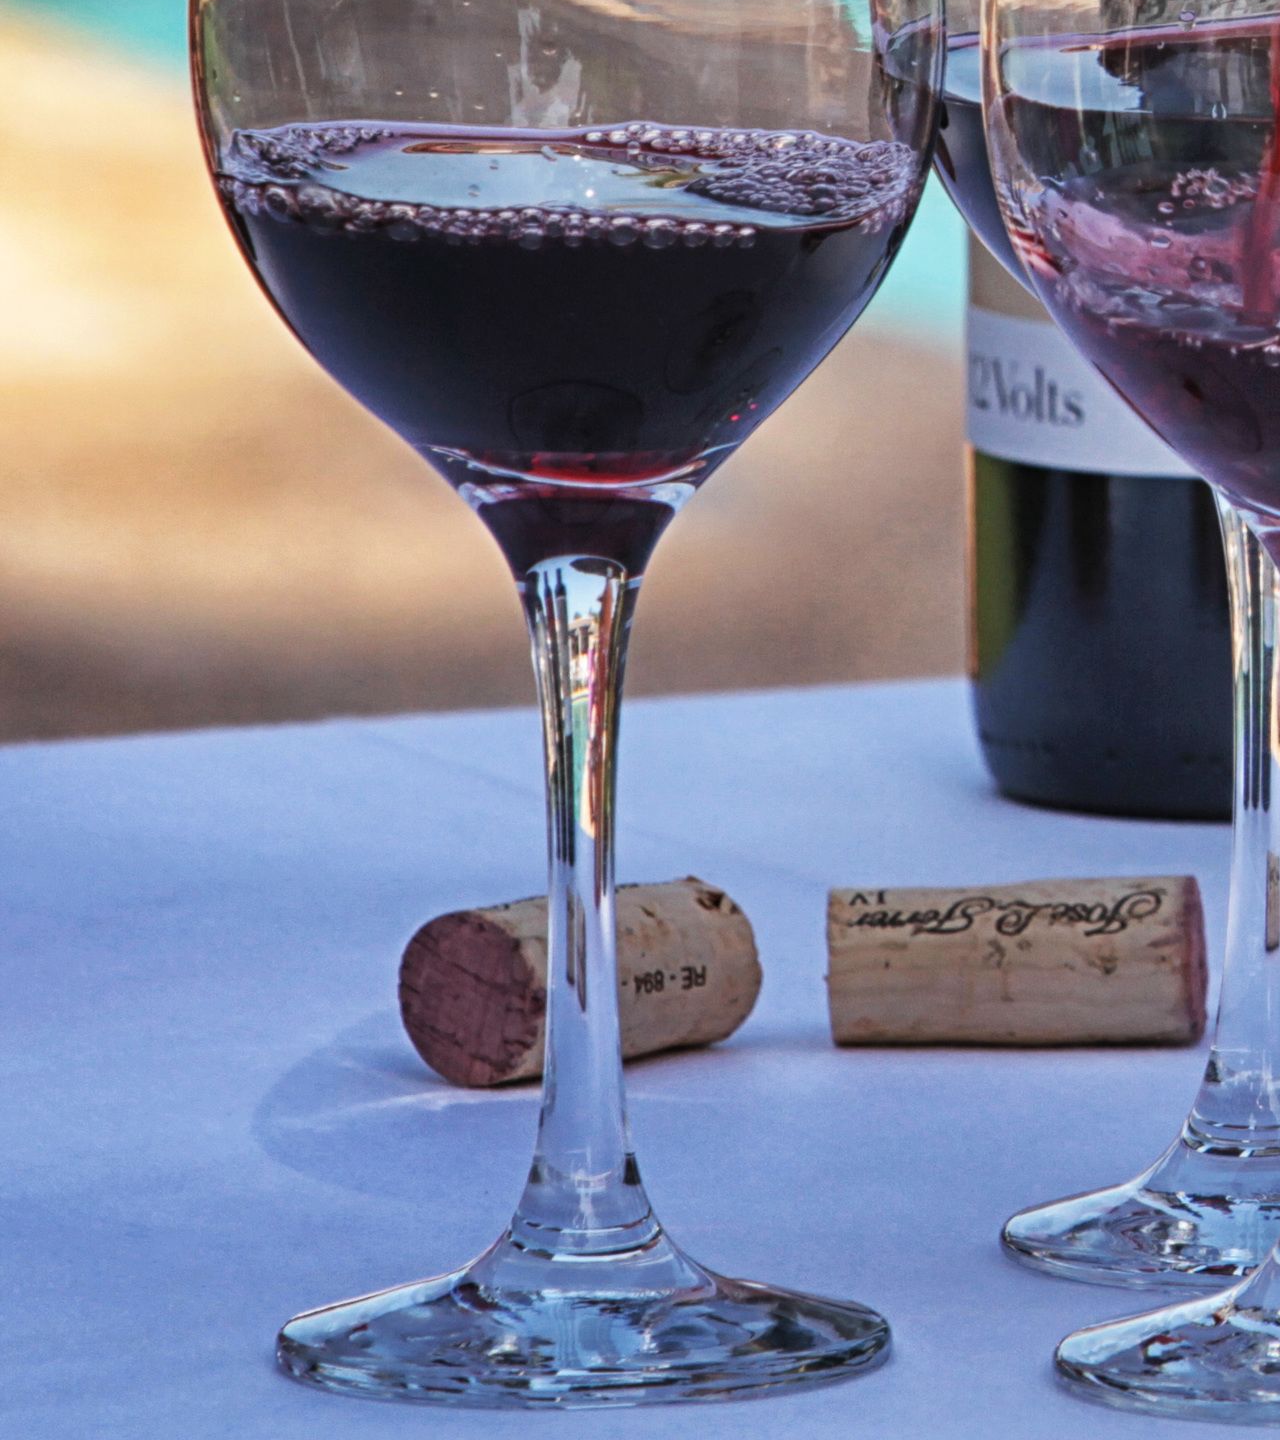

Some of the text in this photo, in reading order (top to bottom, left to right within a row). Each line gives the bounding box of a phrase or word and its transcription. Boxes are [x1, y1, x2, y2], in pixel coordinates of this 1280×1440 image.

[848, 895, 996, 936] Ferrer
[633, 969, 665, 994] 894
[681, 966, 707, 990] RE
